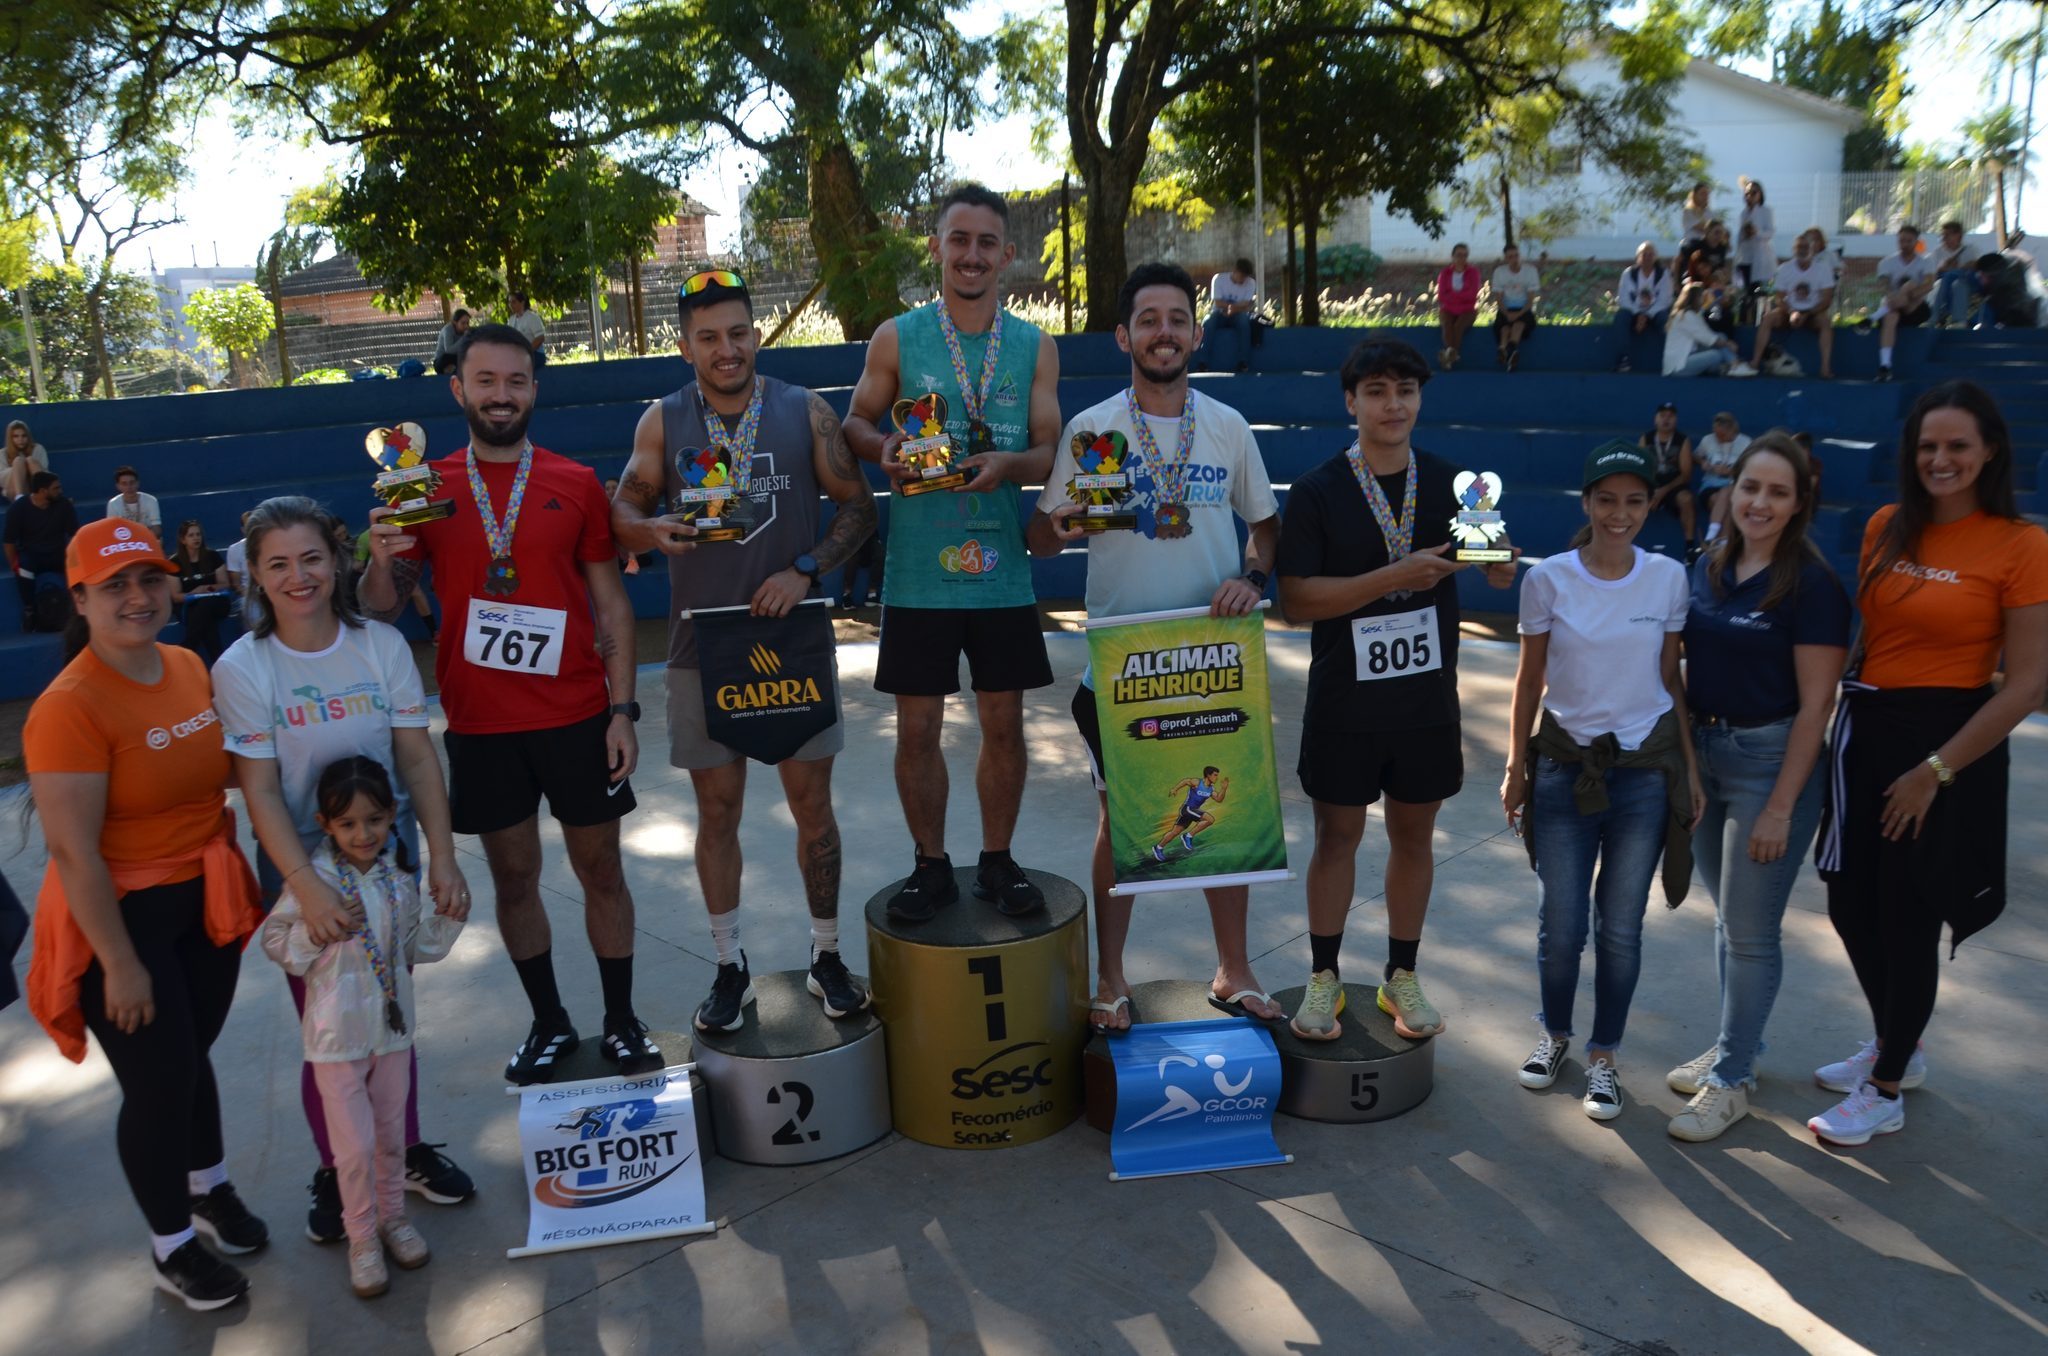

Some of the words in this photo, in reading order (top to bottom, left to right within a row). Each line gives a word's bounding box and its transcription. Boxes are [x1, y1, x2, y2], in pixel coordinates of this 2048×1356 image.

[986, 422, 1021, 434] TEVÓLEI
[751, 475, 791, 493] ROESTE
[1186, 463, 1228, 485] ZOP
[99, 541, 153, 557] CRESOL
[1892, 560, 1961, 584] CRESOL
[479, 625, 551, 668] 767
[1368, 632, 1430, 674] 805
[1123, 644, 1240, 679] ALCIMAR
[716, 677, 822, 711] GARRA
[1117, 667, 1240, 701] HENRIQUE
[171, 708, 219, 738] CRESO
[275, 694, 385, 729] Autismo
[731, 711, 755, 719] centro
[766, 705, 811, 715] treinamento
[1159, 712, 1238, 731] @prof_alcimarh
[1163, 730, 1197, 738] TREINADOR
[967, 955, 1007, 1042] 1
[538, 1076, 675, 1103] ASSESSORIA
[1350, 1071, 1380, 1112] 5
[951, 1100, 1054, 1126] Fecomércio
[1202, 1096, 1268, 1113] GCOR
[1204, 1111, 1263, 1124] Palmitinho
[953, 1129, 1011, 1145] Senac
[535, 1143, 591, 1175] BIG
[598, 1130, 678, 1165] FORT
[618, 1161, 657, 1181] RUN
[541, 1215, 692, 1242] #ÉSÓNÃOPARAR
